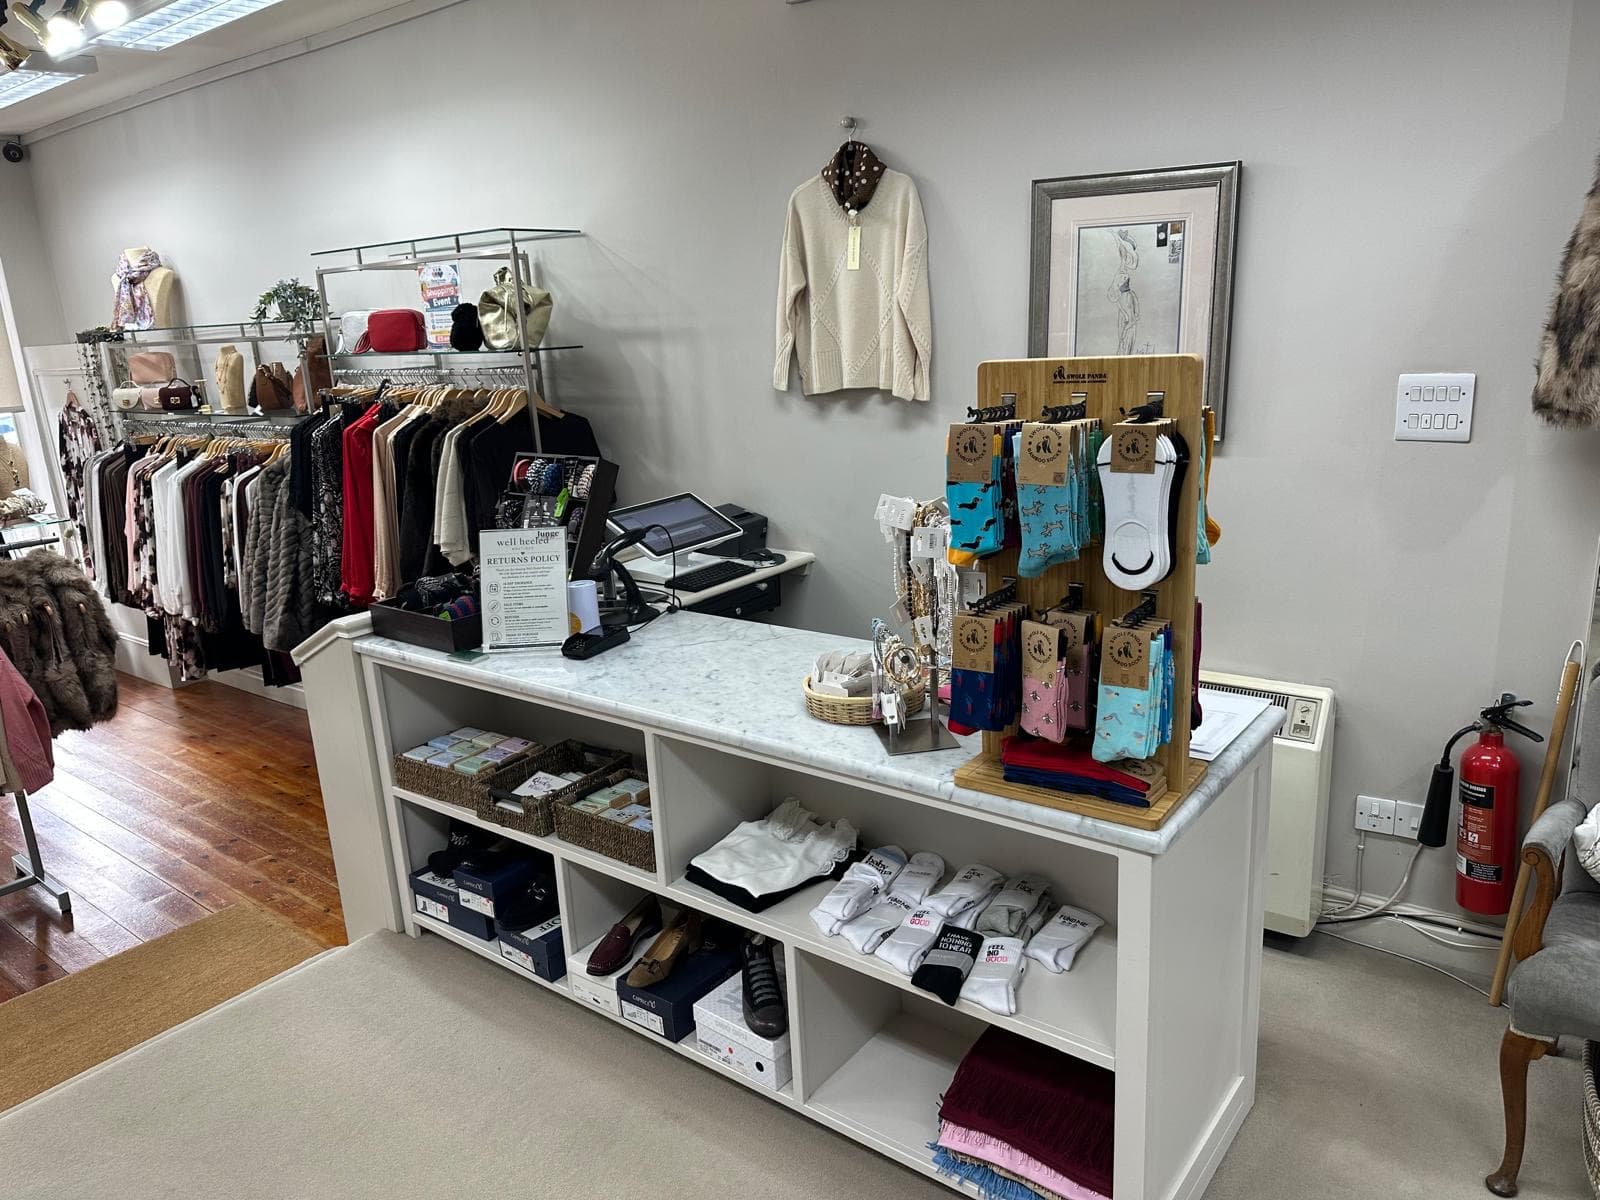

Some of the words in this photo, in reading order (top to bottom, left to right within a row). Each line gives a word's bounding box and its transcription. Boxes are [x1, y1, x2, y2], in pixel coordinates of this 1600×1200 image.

[427, 287, 456, 297] Shopping
[432, 297, 451, 307] Event
[537, 530, 560, 538] Junge
[497, 538, 517, 546] well
[519, 536, 549, 546] heeled
[487, 556, 529, 566] RETURNS
[530, 554, 561, 563] POLICY
[865, 855, 889, 870] baby
[909, 918, 930, 926] GOOD
[940, 936, 973, 948] NOTHING
[948, 944, 972, 954] WEAR
